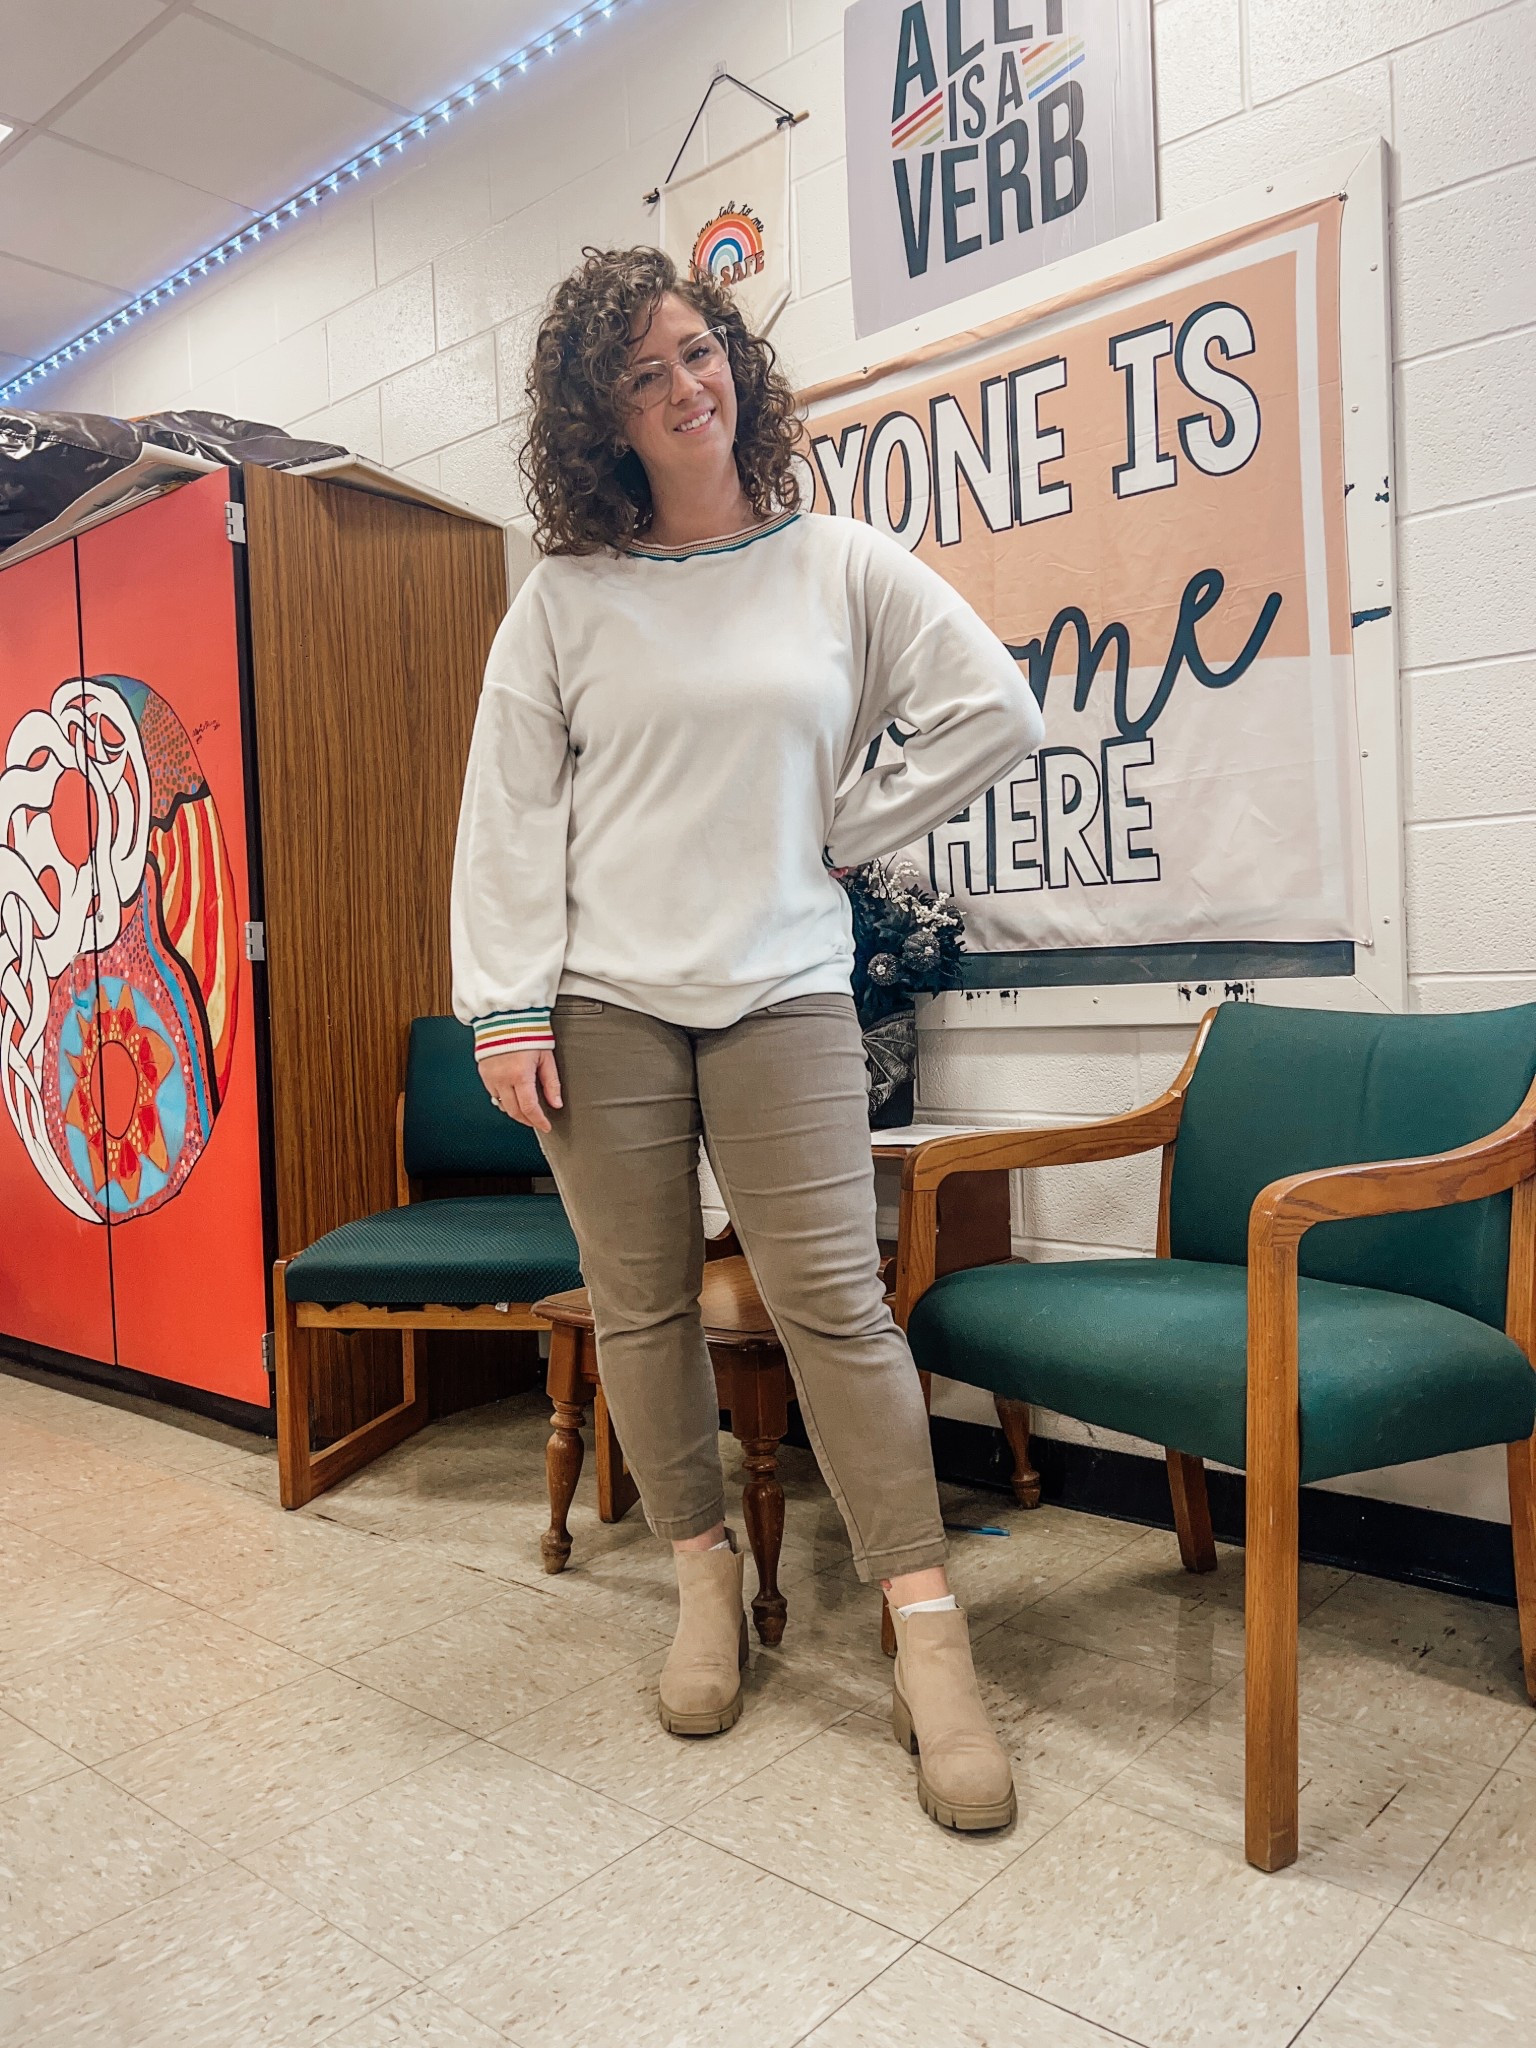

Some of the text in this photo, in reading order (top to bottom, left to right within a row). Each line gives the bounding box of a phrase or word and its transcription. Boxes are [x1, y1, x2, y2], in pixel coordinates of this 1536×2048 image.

[947, 50, 1024, 142] IS A
[892, 80, 1089, 280] VERB
[720, 249, 765, 288] SAFE
[778, 301, 1261, 554] YONE IS
